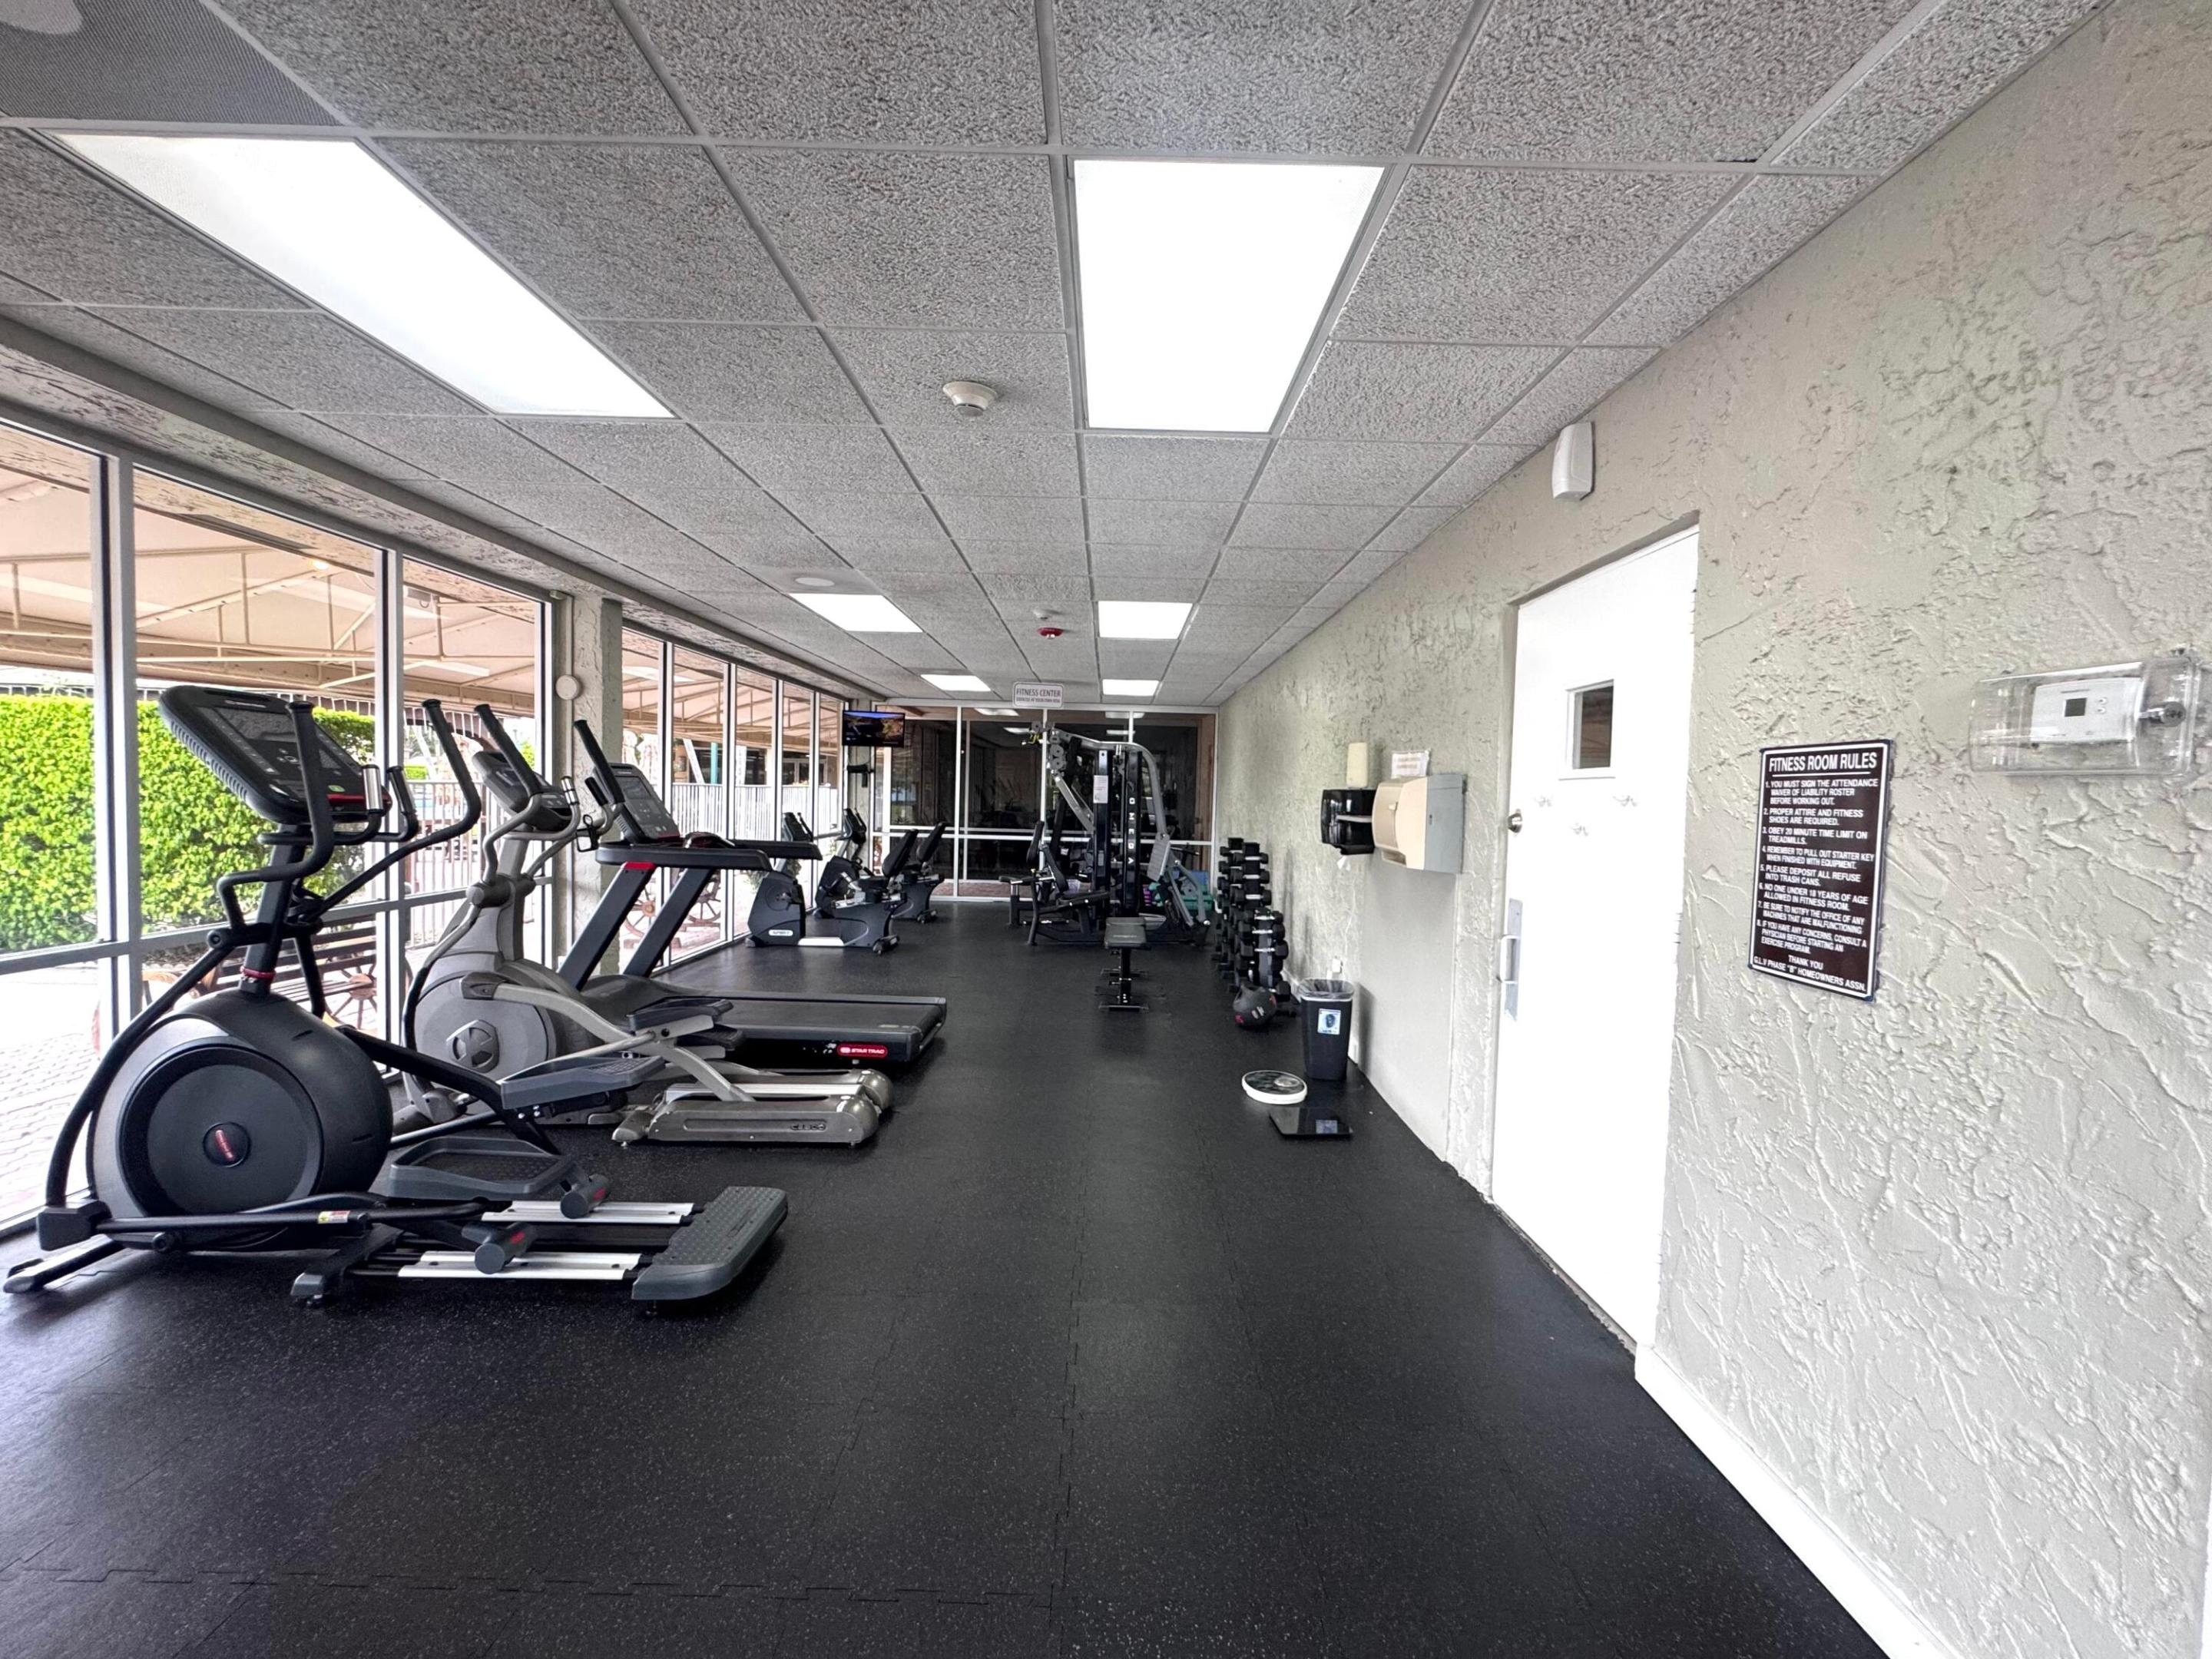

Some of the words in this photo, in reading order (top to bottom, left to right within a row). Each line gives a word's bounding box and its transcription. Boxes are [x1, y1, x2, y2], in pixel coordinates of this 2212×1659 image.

[1016, 688, 1038, 697] FITNESS
[1039, 689, 1061, 697] CENTER
[1770, 756, 1805, 772] FITNESS
[1808, 754, 1838, 770] ROOM
[1840, 752, 1877, 769] RULES
[1793, 828, 1817, 836] MINUTE
[1856, 831, 1867, 839] ON
[1767, 846, 1795, 854] REMEMBER
[1833, 851, 1859, 860] STARTER
[1782, 856, 1805, 864] FINISHED
[1766, 865, 1788, 873] PLEASE
[1790, 867, 1816, 876] DEPOSIT
[1818, 870, 1830, 879] ALL
[1832, 872, 1861, 882] REFUSE
[1780, 875, 1800, 883] TRASH
[1764, 892, 1791, 902] ALLOWED
[1800, 896, 1826, 907] FITNESS
[1787, 886, 1807, 896] UNDER
[1818, 890, 1839, 899] YEARS
[1841, 893, 1850, 902] OF
[1852, 896, 1869, 904] AGE
[1763, 910, 1786, 920] MACHINES
[1813, 918, 1862, 934] MALFUNCTIONING
[1792, 907, 1810, 916] NOTIFY
[1822, 911, 1841, 920] OFFICE
[1852, 916, 1865, 925] ANY
[1761, 936, 1783, 947] EXERCISE
[1778, 923, 1790, 932] HAVE
[1834, 934, 1861, 946] CONSULT
[1786, 933, 1806, 943] BEFORE
[1808, 937, 1833, 949] STARTING
[1788, 955, 1809, 966] THANK
[1810, 960, 1823, 970] YOU
[1767, 960, 1786, 971] PHASE
[1797, 968, 1844, 986] HOMEOWNERS
